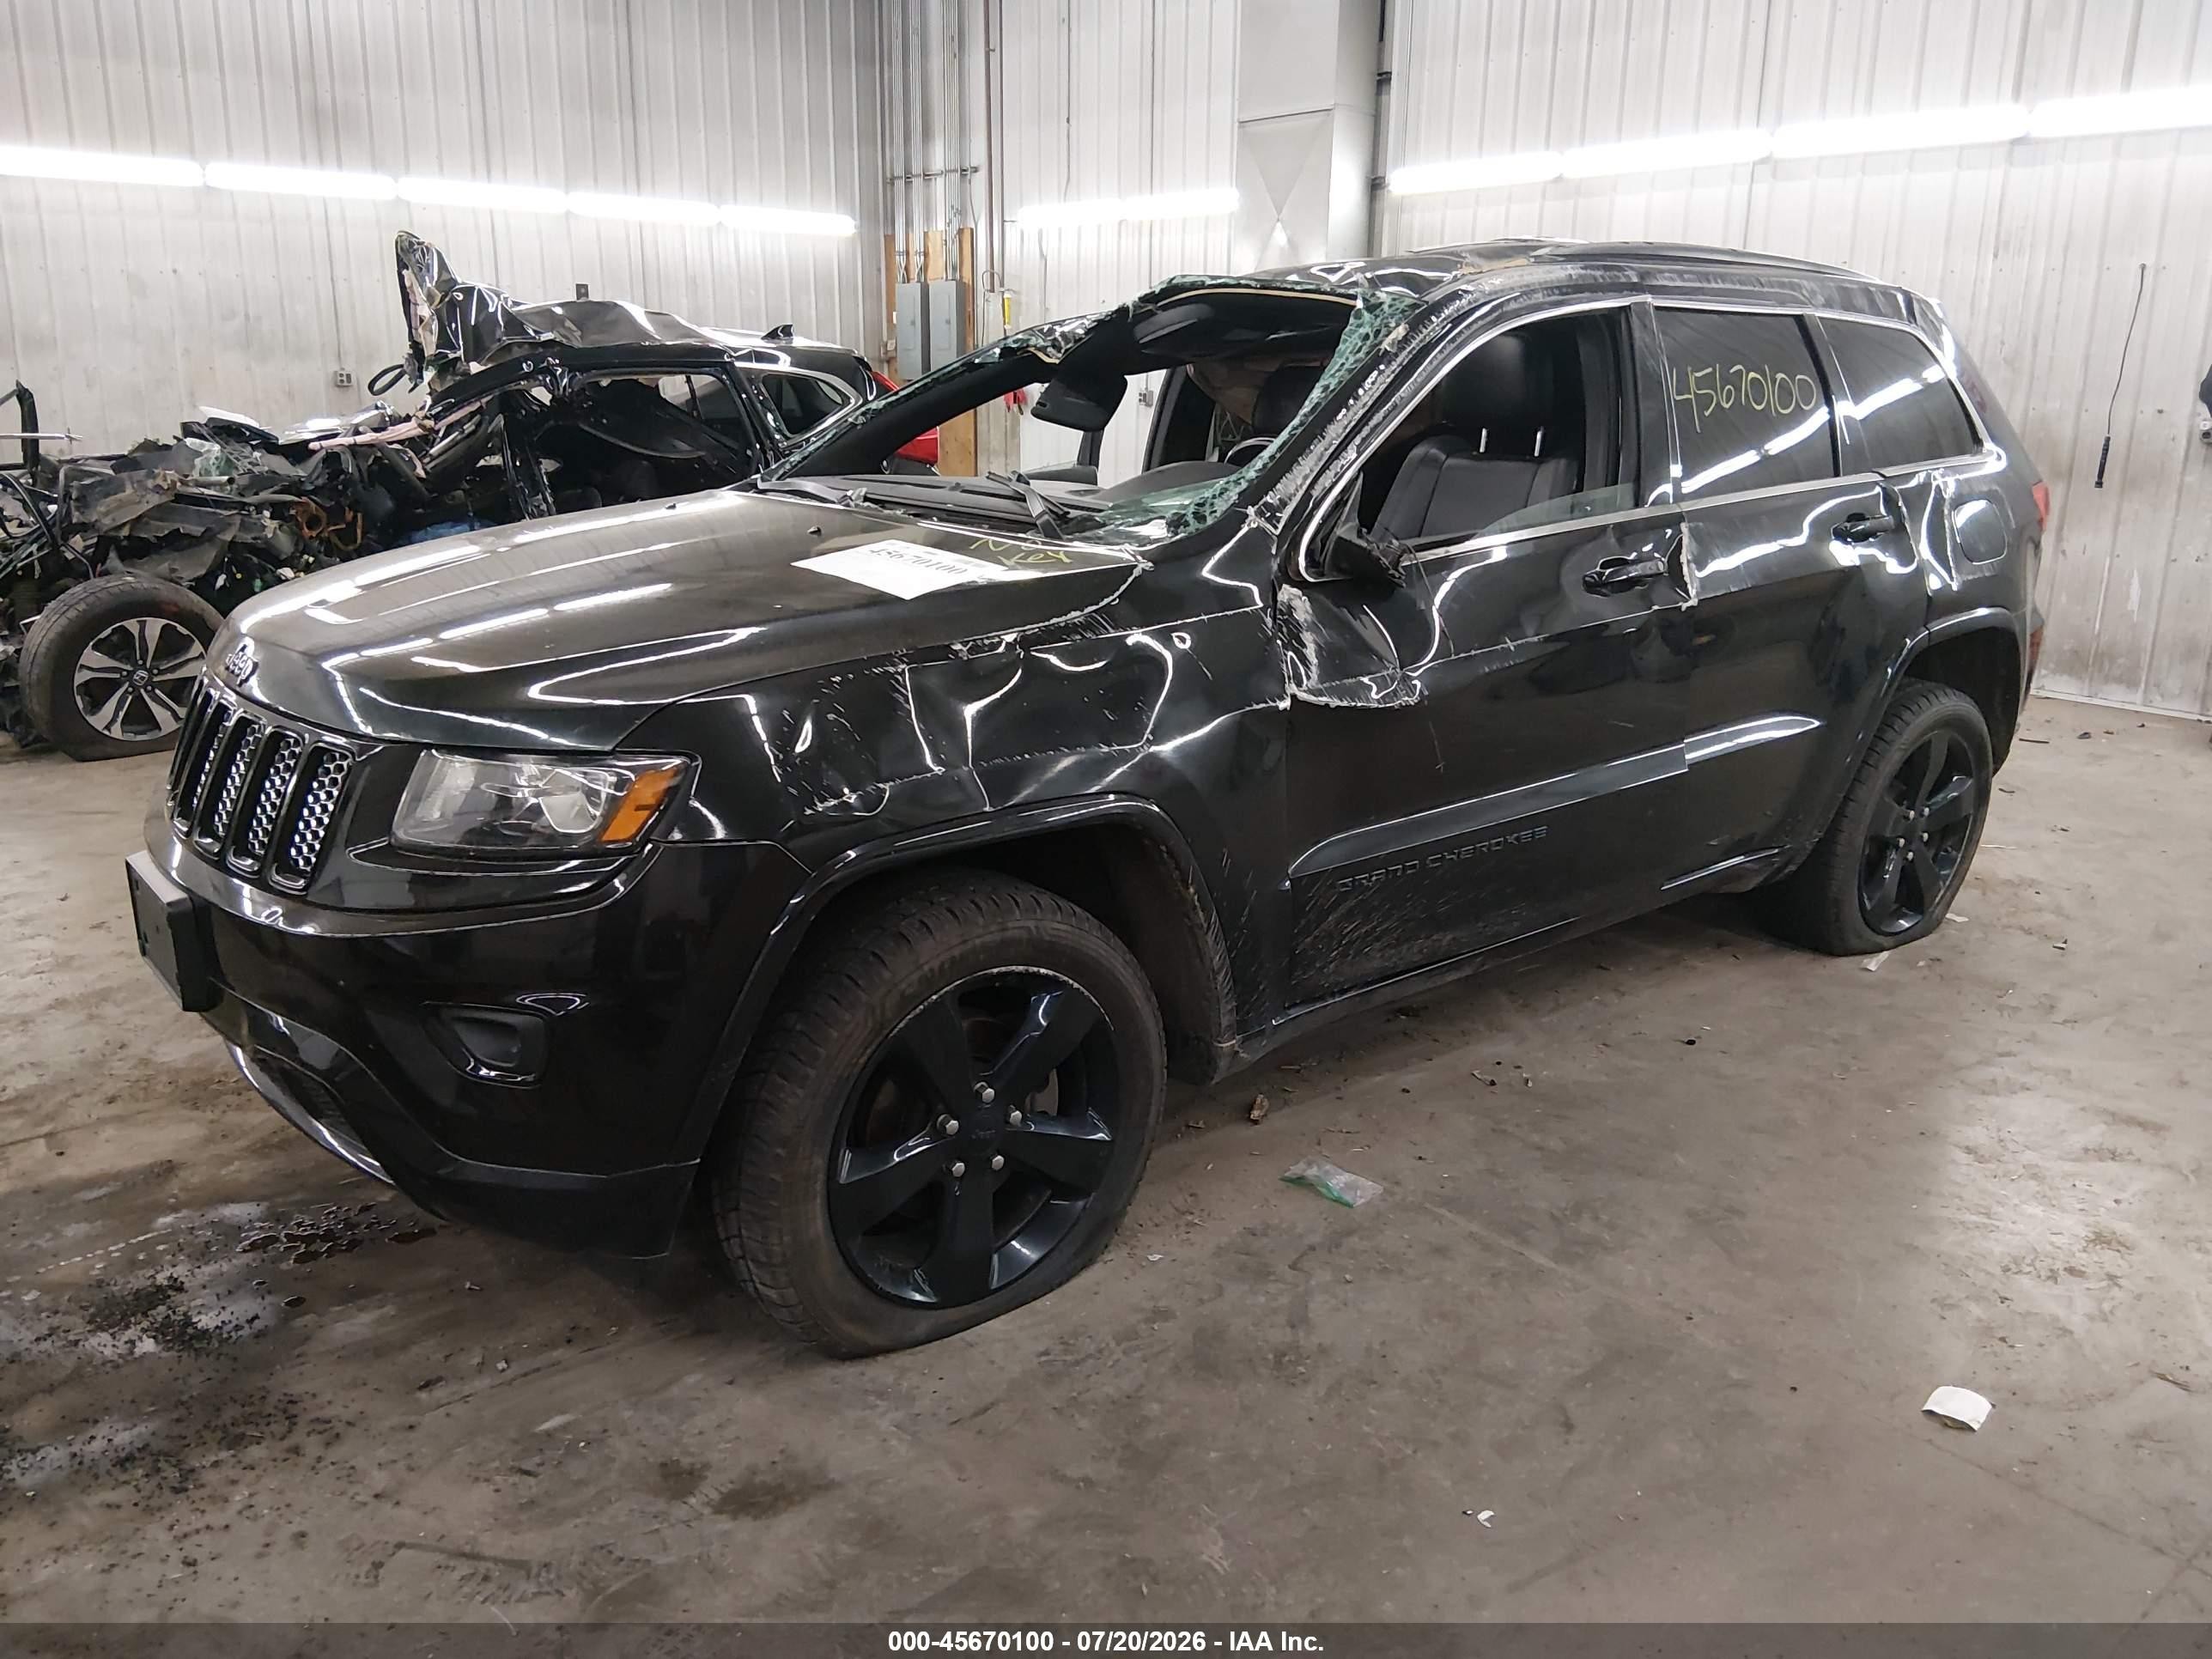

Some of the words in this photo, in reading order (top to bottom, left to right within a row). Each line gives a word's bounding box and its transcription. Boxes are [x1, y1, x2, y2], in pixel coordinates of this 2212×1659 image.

[1673, 364, 1817, 434] 45670100
[1337, 860, 1419, 892] GRAND
[1425, 825, 1548, 869] CHEROKEE
